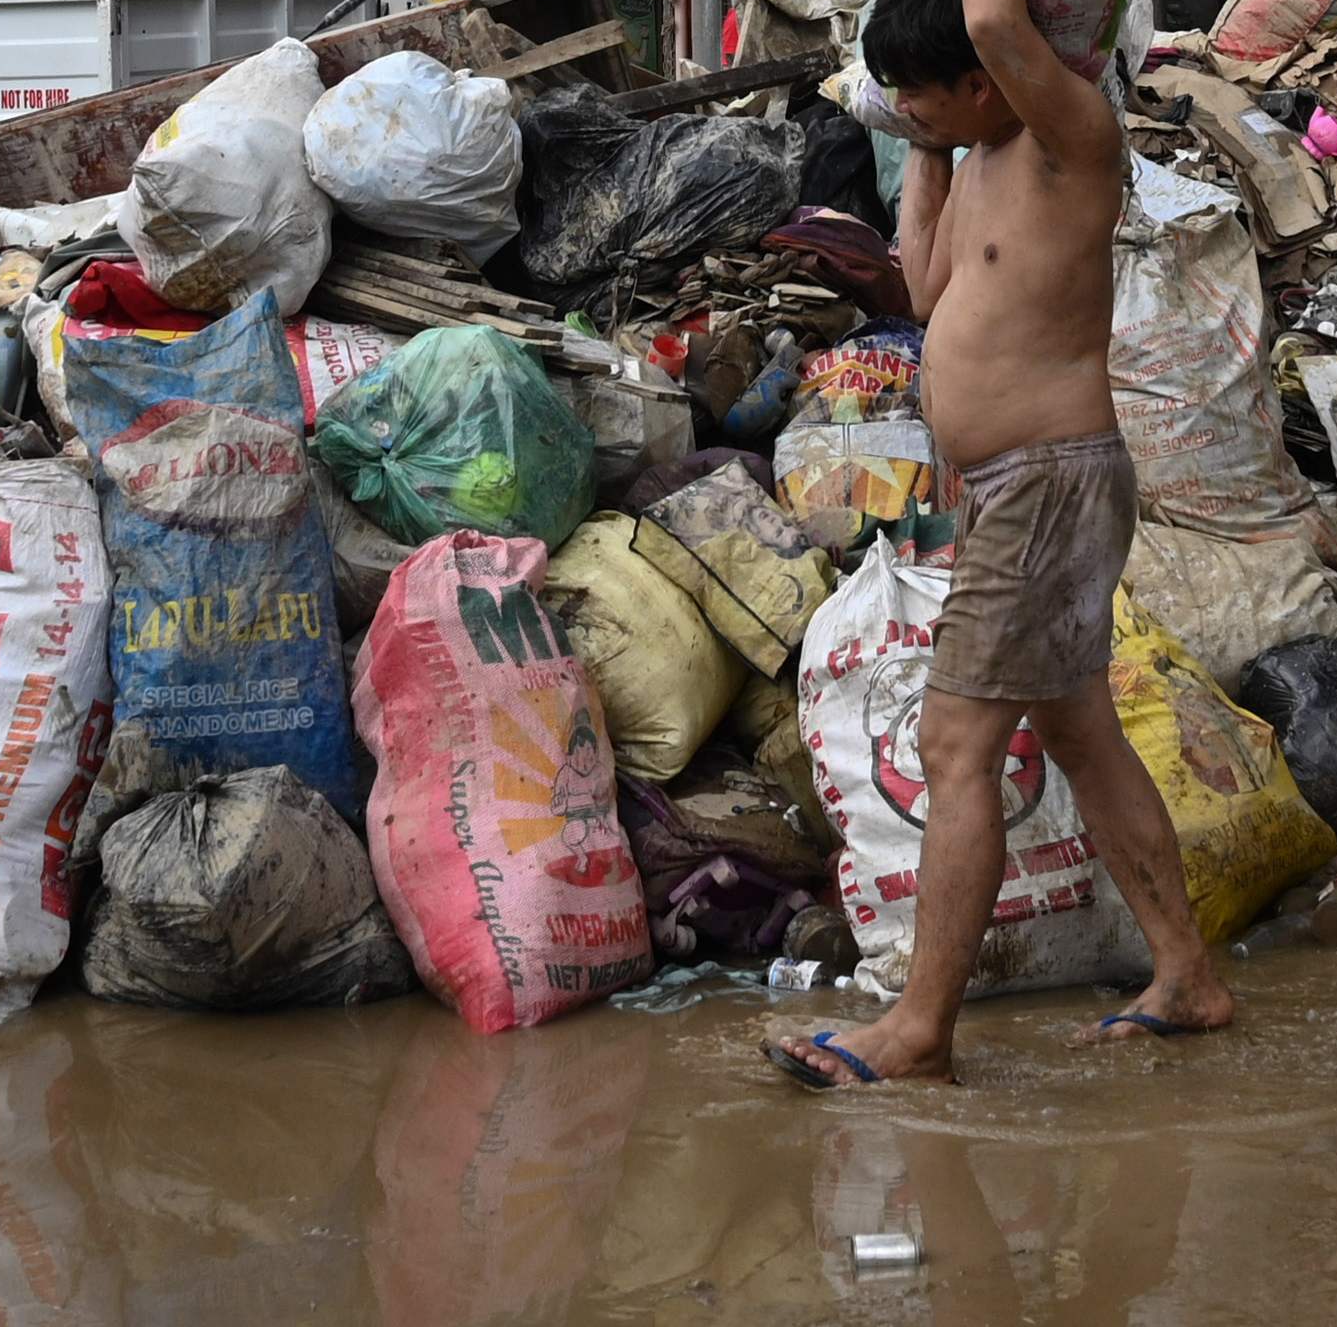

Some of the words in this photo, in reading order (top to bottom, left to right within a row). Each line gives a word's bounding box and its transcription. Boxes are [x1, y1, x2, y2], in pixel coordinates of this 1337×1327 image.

[1, 90, 22, 109] NOT
[24, 89, 44, 109] FOR
[45, 88, 69, 109] HIRE
[1162, 427, 1217, 456] GRADE
[123, 588, 321, 654] LAPU-LAPU
[142, 682, 242, 709] SPECIAL
[245, 677, 299, 700] RICE
[443, 759, 477, 852] Super
[544, 963, 583, 992] NET
